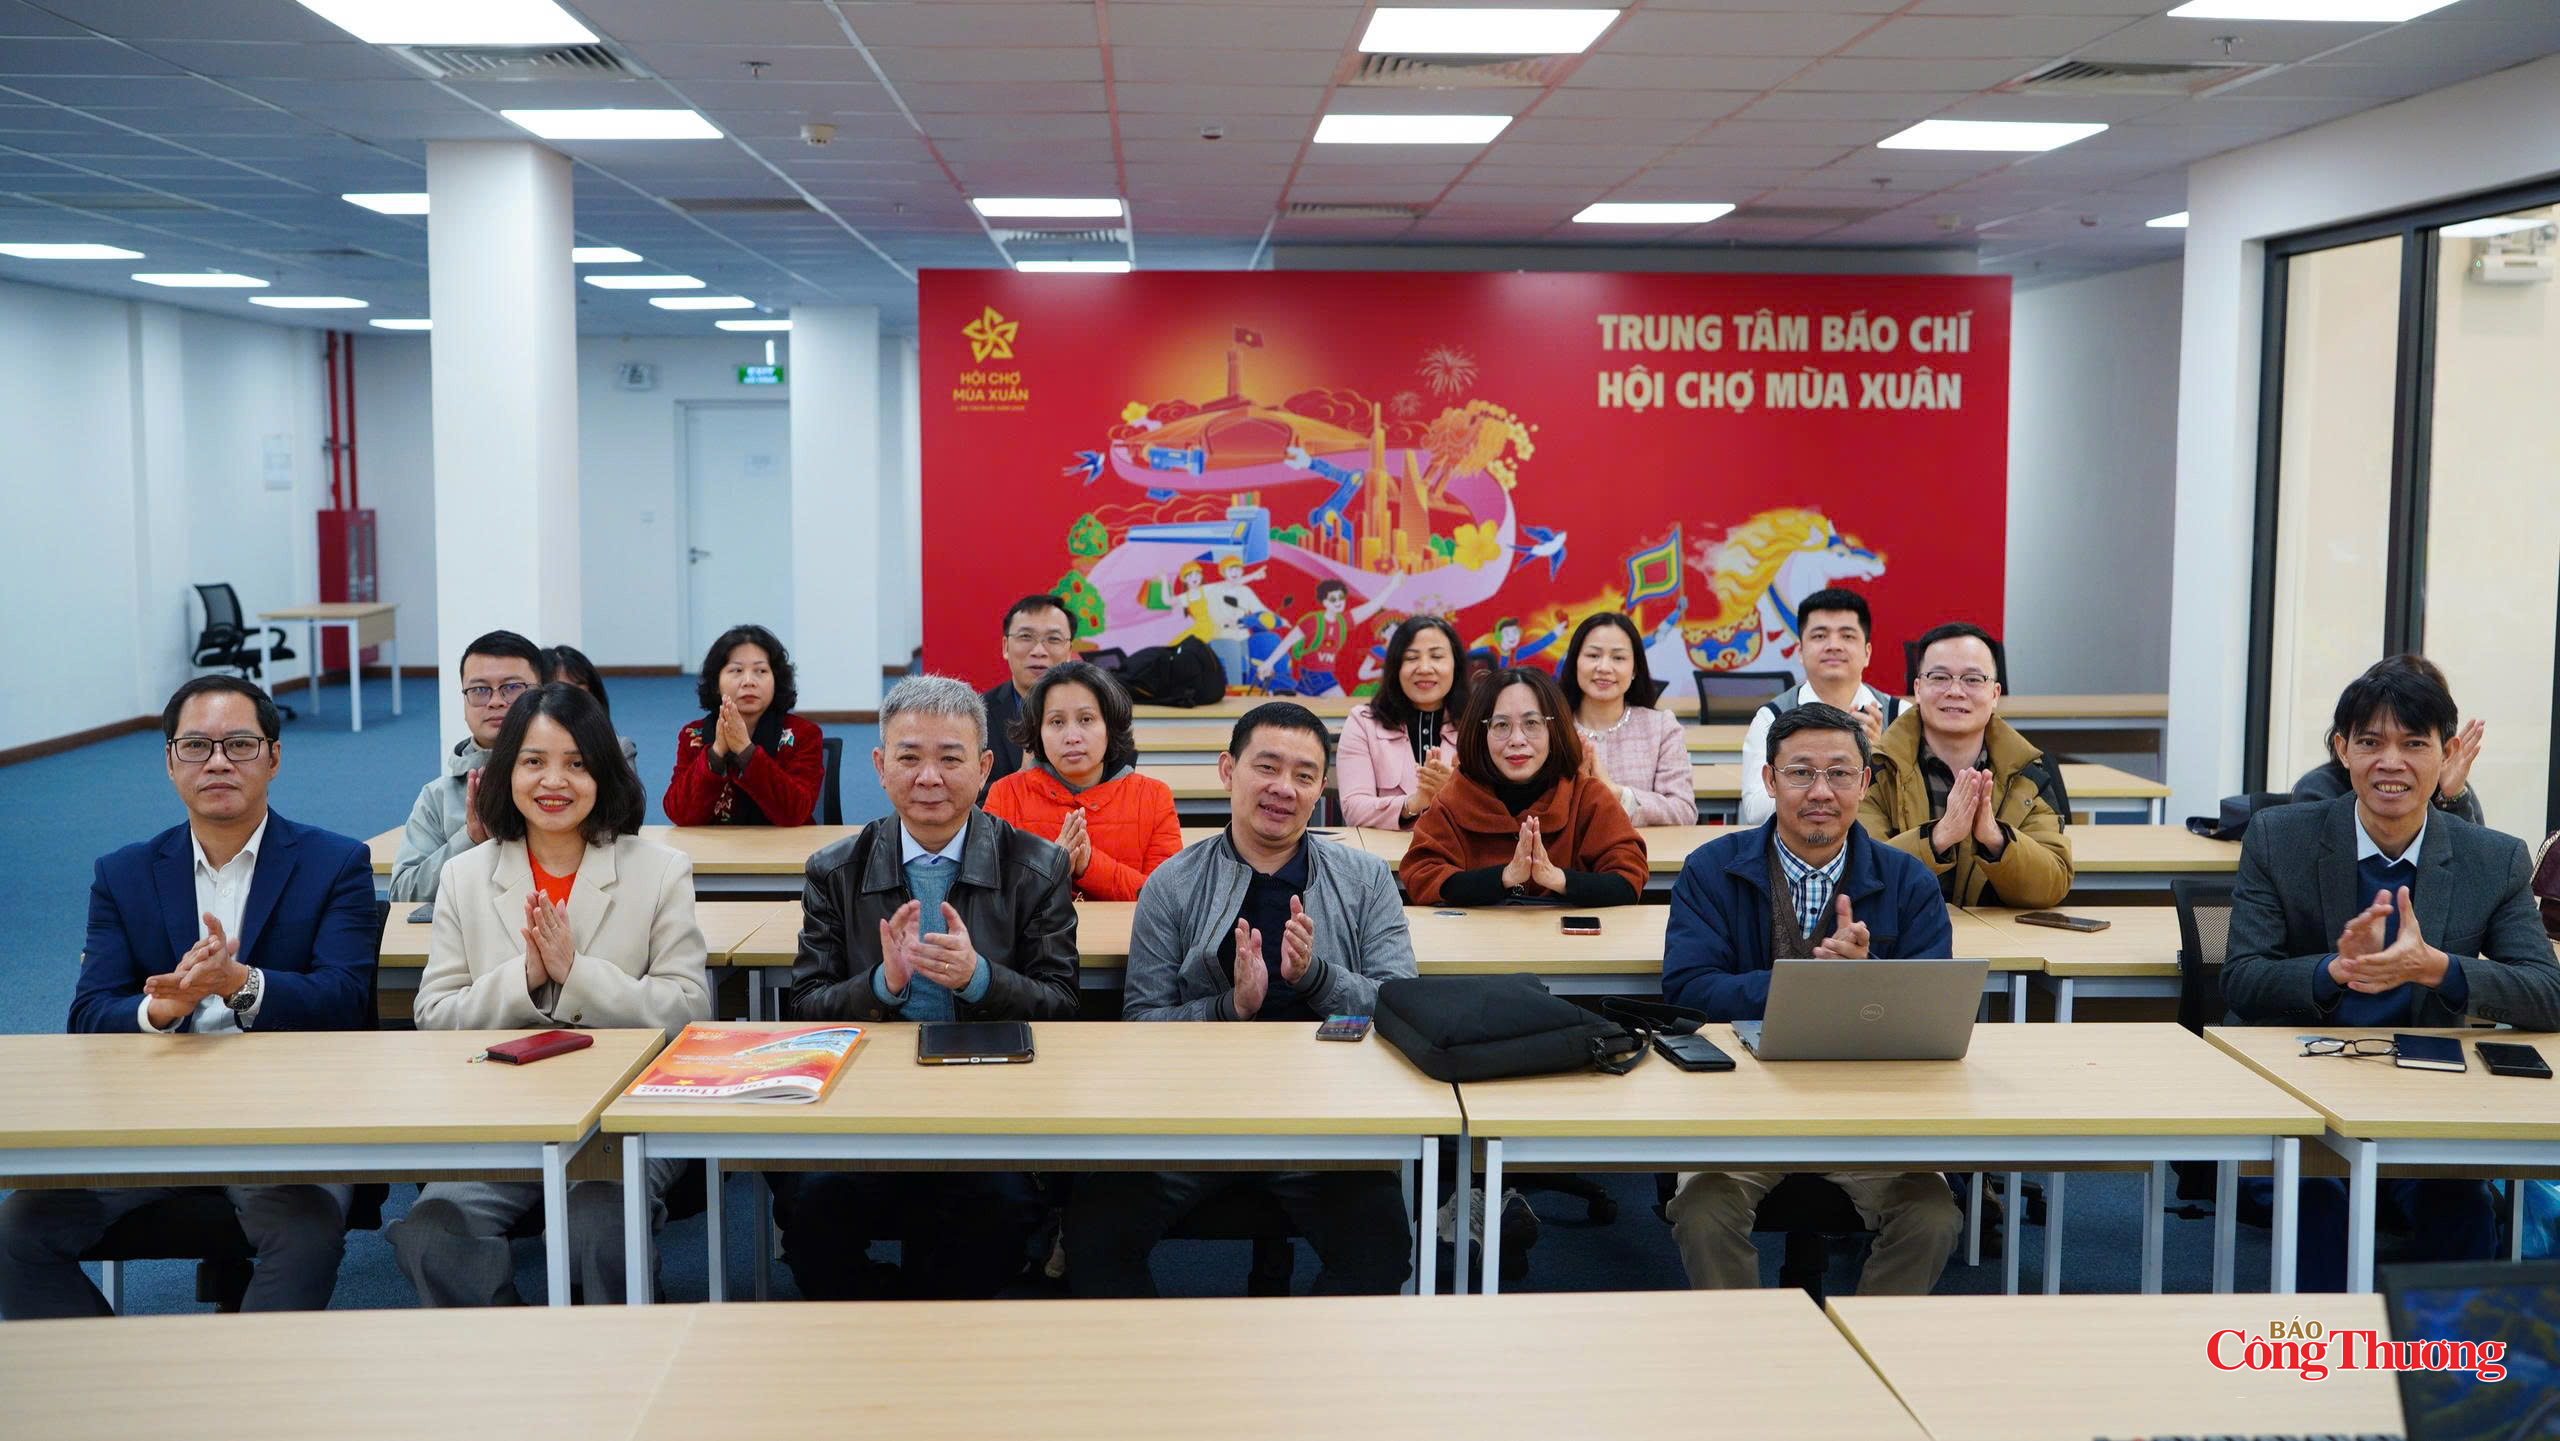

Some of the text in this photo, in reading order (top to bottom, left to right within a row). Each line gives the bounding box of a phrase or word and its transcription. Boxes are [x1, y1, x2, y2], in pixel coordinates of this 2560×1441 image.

[1597, 308, 1973, 353] TRUNG TÂM BÁO CHÍ
[960, 370, 1021, 386] HỘI CHỢ
[953, 385, 1029, 401] MÙA XUÂN
[1598, 364, 1962, 413] HỘI CHỢ MÙA XUÂN
[1318, 651, 1336, 663] VN
